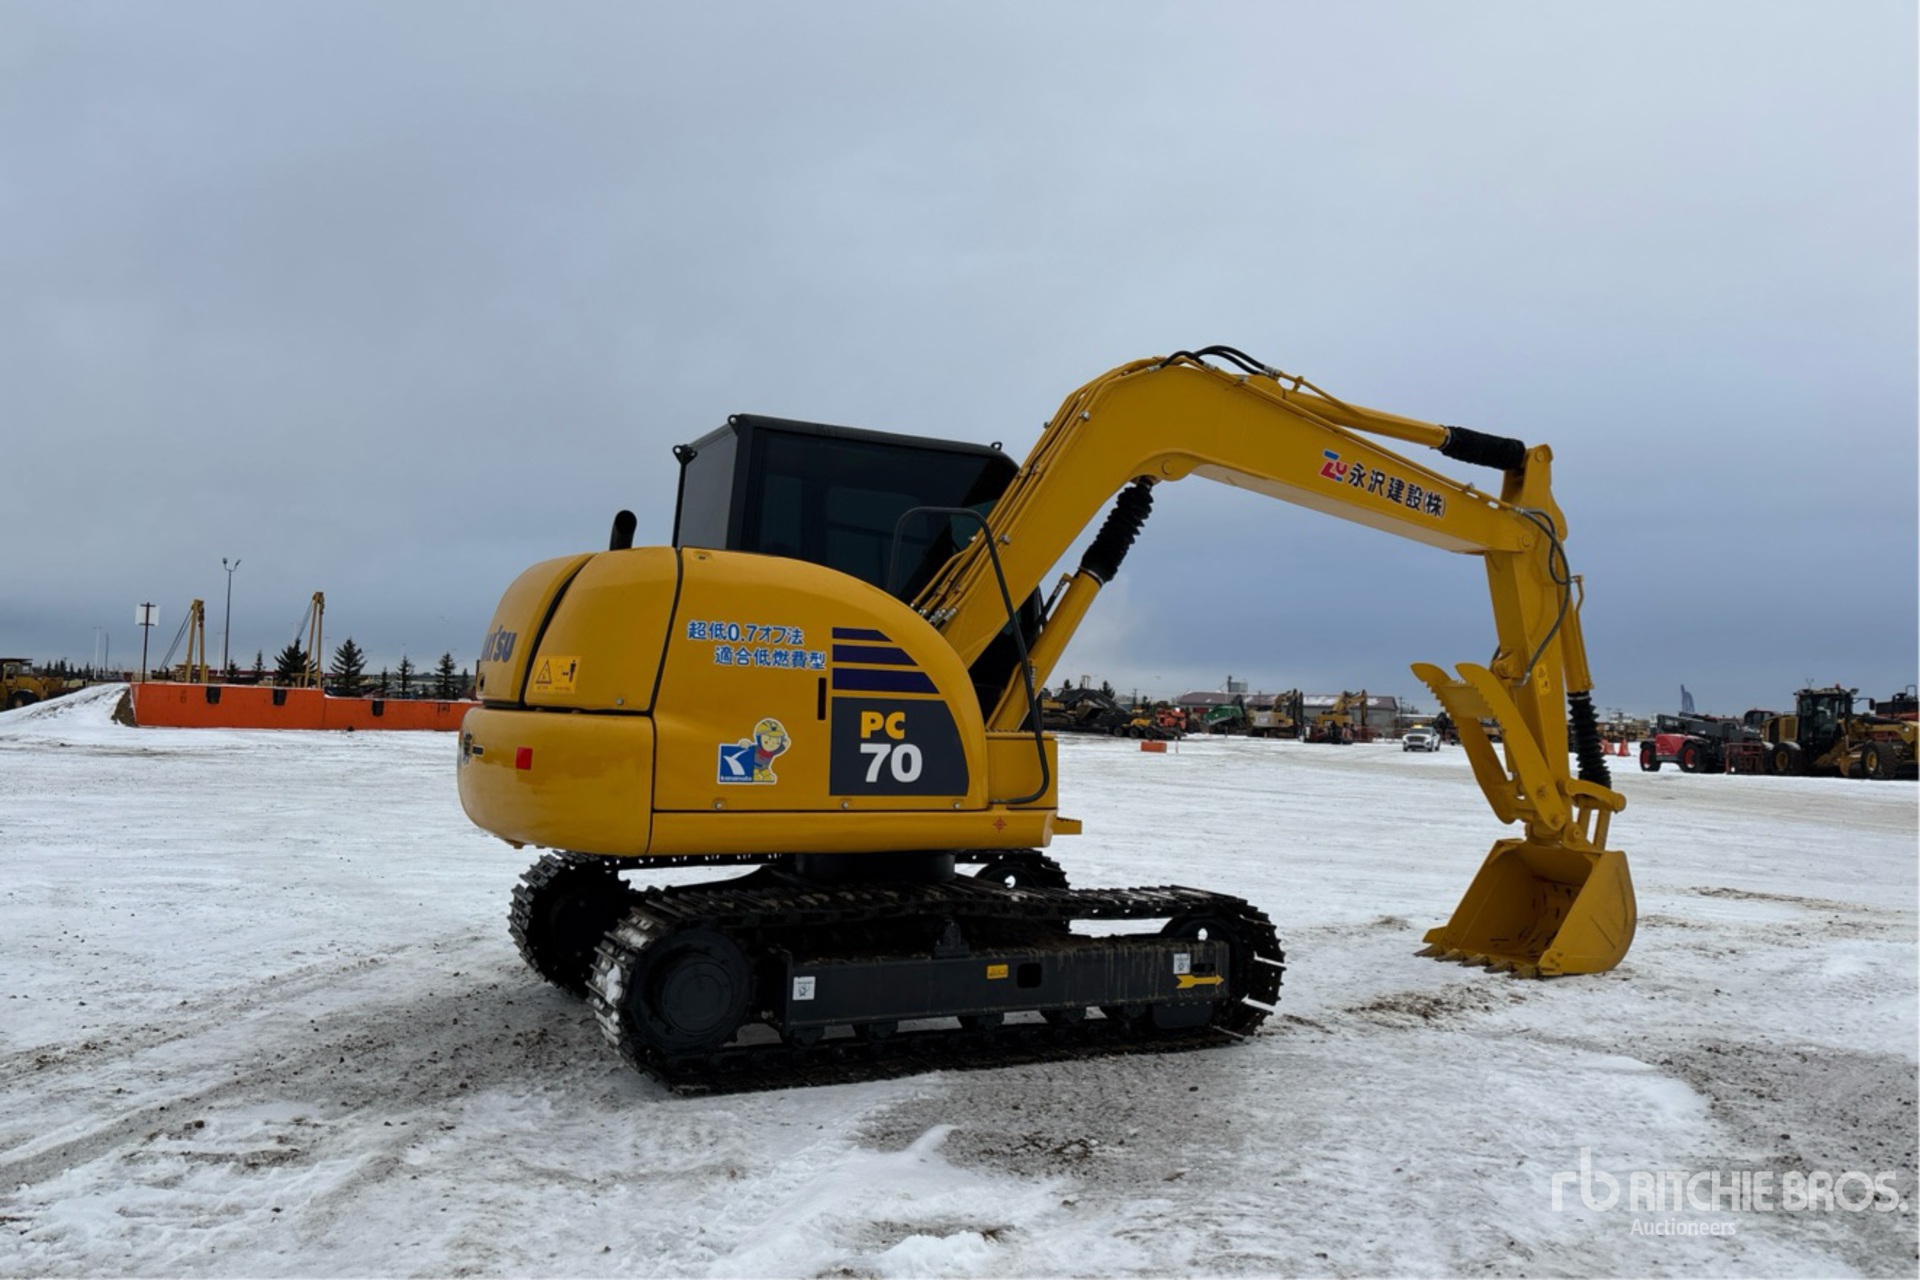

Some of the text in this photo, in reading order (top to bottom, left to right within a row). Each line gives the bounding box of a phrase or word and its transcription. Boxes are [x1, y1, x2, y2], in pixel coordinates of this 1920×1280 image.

[714, 645, 826, 670] 適合低燃費型
[860, 711, 906, 740] PC
[860, 743, 923, 783] 70
